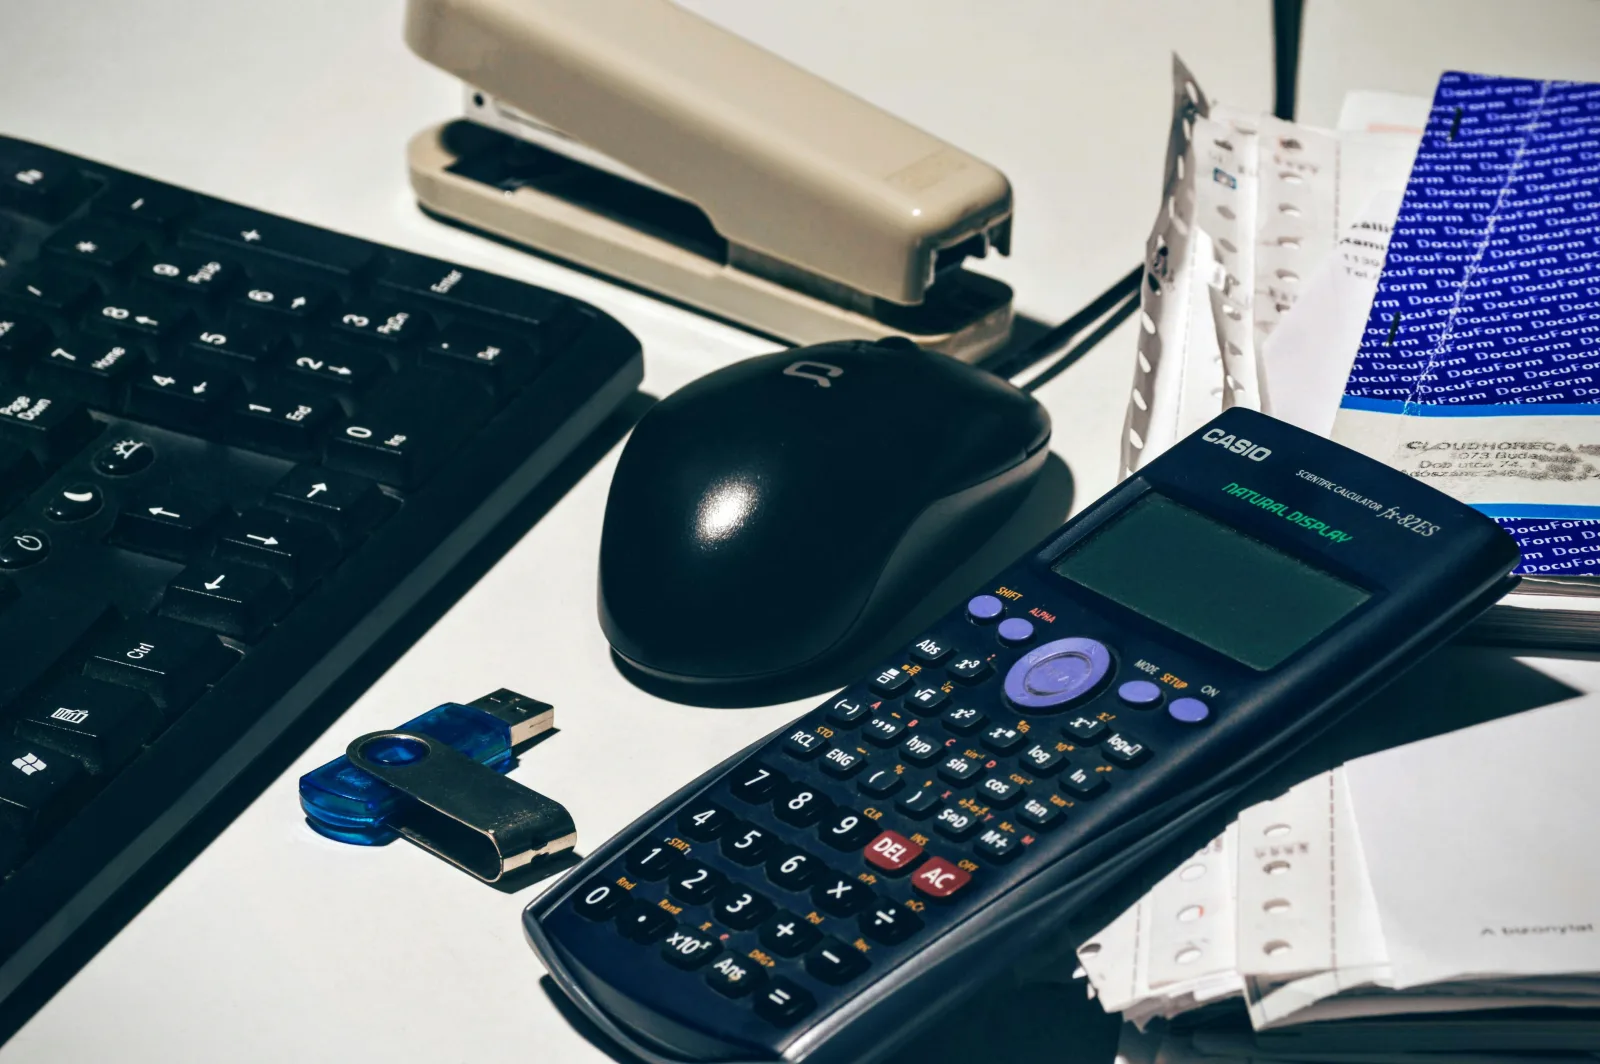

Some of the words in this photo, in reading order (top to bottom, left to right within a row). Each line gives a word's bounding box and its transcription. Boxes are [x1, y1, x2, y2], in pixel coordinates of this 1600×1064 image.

[1490, 240, 1585, 259] DocuForm
[1436, 272, 1530, 289] DocuForm
[1482, 291, 1578, 310] DocuForm
[342, 313, 370, 327] 3
[1454, 307, 1550, 326] DocuForm
[200, 332, 226, 345] 5
[1503, 325, 1600, 345] DocuForm
[51, 348, 76, 361] 7
[92, 347, 126, 370] Home
[1475, 341, 1572, 361] DocuForm
[296, 357, 323, 370] 2
[1447, 358, 1544, 379] DocuForm
[152, 375, 175, 387] 4
[1419, 374, 1515, 394] DocuForm
[1495, 375, 1593, 396] DocuForm
[286, 405, 312, 421] End
[1202, 428, 1272, 462] CASIO
[1296, 469, 1335, 491] SCIENTIFIC
[1334, 486, 1382, 511] CALCULATOR
[1376, 505, 1441, 537] fx-82ES
[1222, 482, 1286, 517] NATURAL
[1286, 511, 1353, 543] DISPLAY
[995, 586, 1023, 601] SHIFT
[1029, 607, 1057, 624] ALPHA
[126, 642, 155, 659] Ctrl
[916, 639, 940, 655] Abs
[1135, 659, 1160, 675] MODE
[1160, 672, 1188, 690] SETUP
[1201, 684, 1220, 698] ON
[870, 701, 882, 709] A
[791, 730, 815, 748] RCL
[815, 726, 834, 738] STO
[906, 735, 932, 754] hyp
[945, 739, 956, 747] C
[826, 748, 855, 766] ENG
[1028, 745, 1051, 763] log
[946, 758, 969, 773] sin
[744, 769, 770, 786] 7
[1070, 769, 1087, 783] ln
[985, 779, 1010, 794] cos
[788, 792, 813, 810] 8
[1024, 799, 1048, 817] tan
[692, 810, 716, 826] 4
[863, 808, 883, 820] CLR
[832, 816, 858, 834] 9
[734, 830, 762, 849] 5
[910, 833, 929, 846] INS
[981, 830, 1008, 848] M+
[640, 848, 662, 865] 1
[873, 837, 907, 862] DEL
[780, 855, 806, 873] 6
[957, 860, 979, 872] OFF
[616, 876, 637, 891] Rnd
[681, 869, 708, 889] 2
[920, 868, 955, 888] AC
[585, 886, 610, 904] 0
[726, 893, 753, 913] 3
[714, 958, 746, 981] Ans
